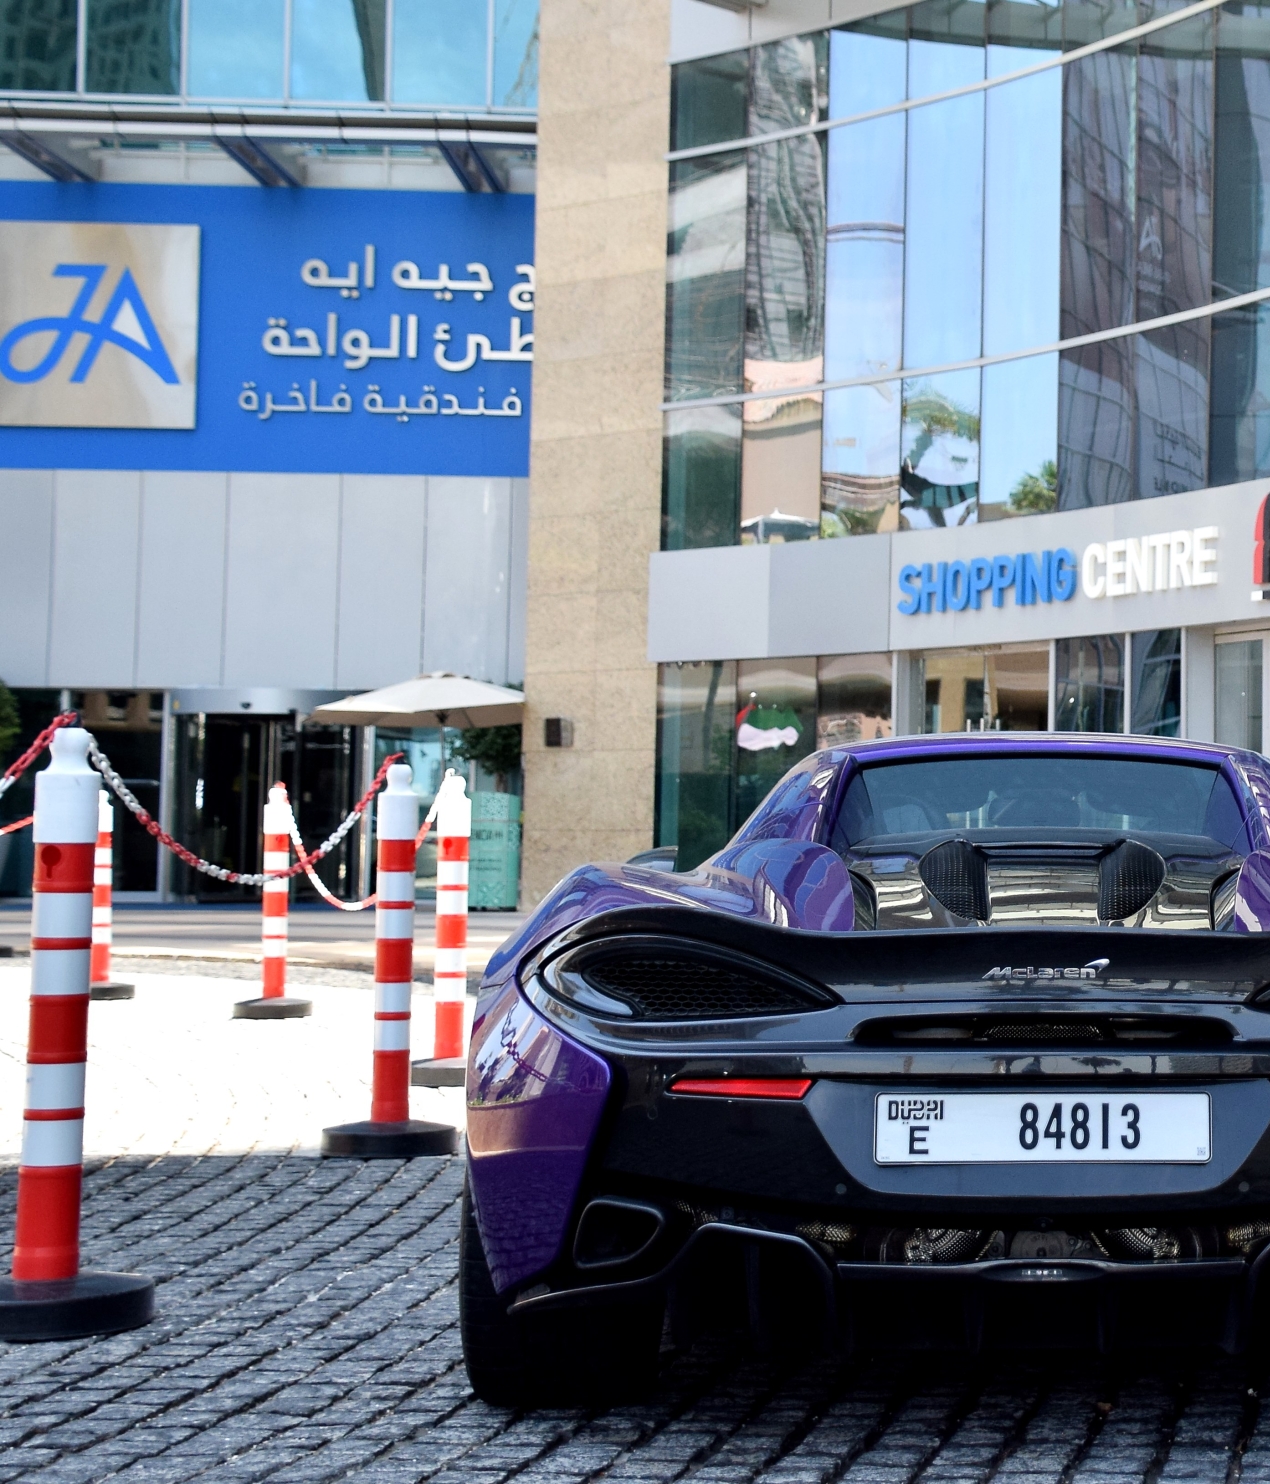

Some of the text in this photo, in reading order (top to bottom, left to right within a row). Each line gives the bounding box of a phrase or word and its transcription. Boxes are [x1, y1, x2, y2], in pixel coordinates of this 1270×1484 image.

[262, 312, 418, 370] الواحة
[239, 379, 523, 422] فندقية فاخرة
[898, 525, 1219, 616] SHOPPING CENTRE
[982, 966, 1096, 979] McLaren
[909, 1126, 930, 1154] E
[1019, 1102, 1141, 1150] 84813
